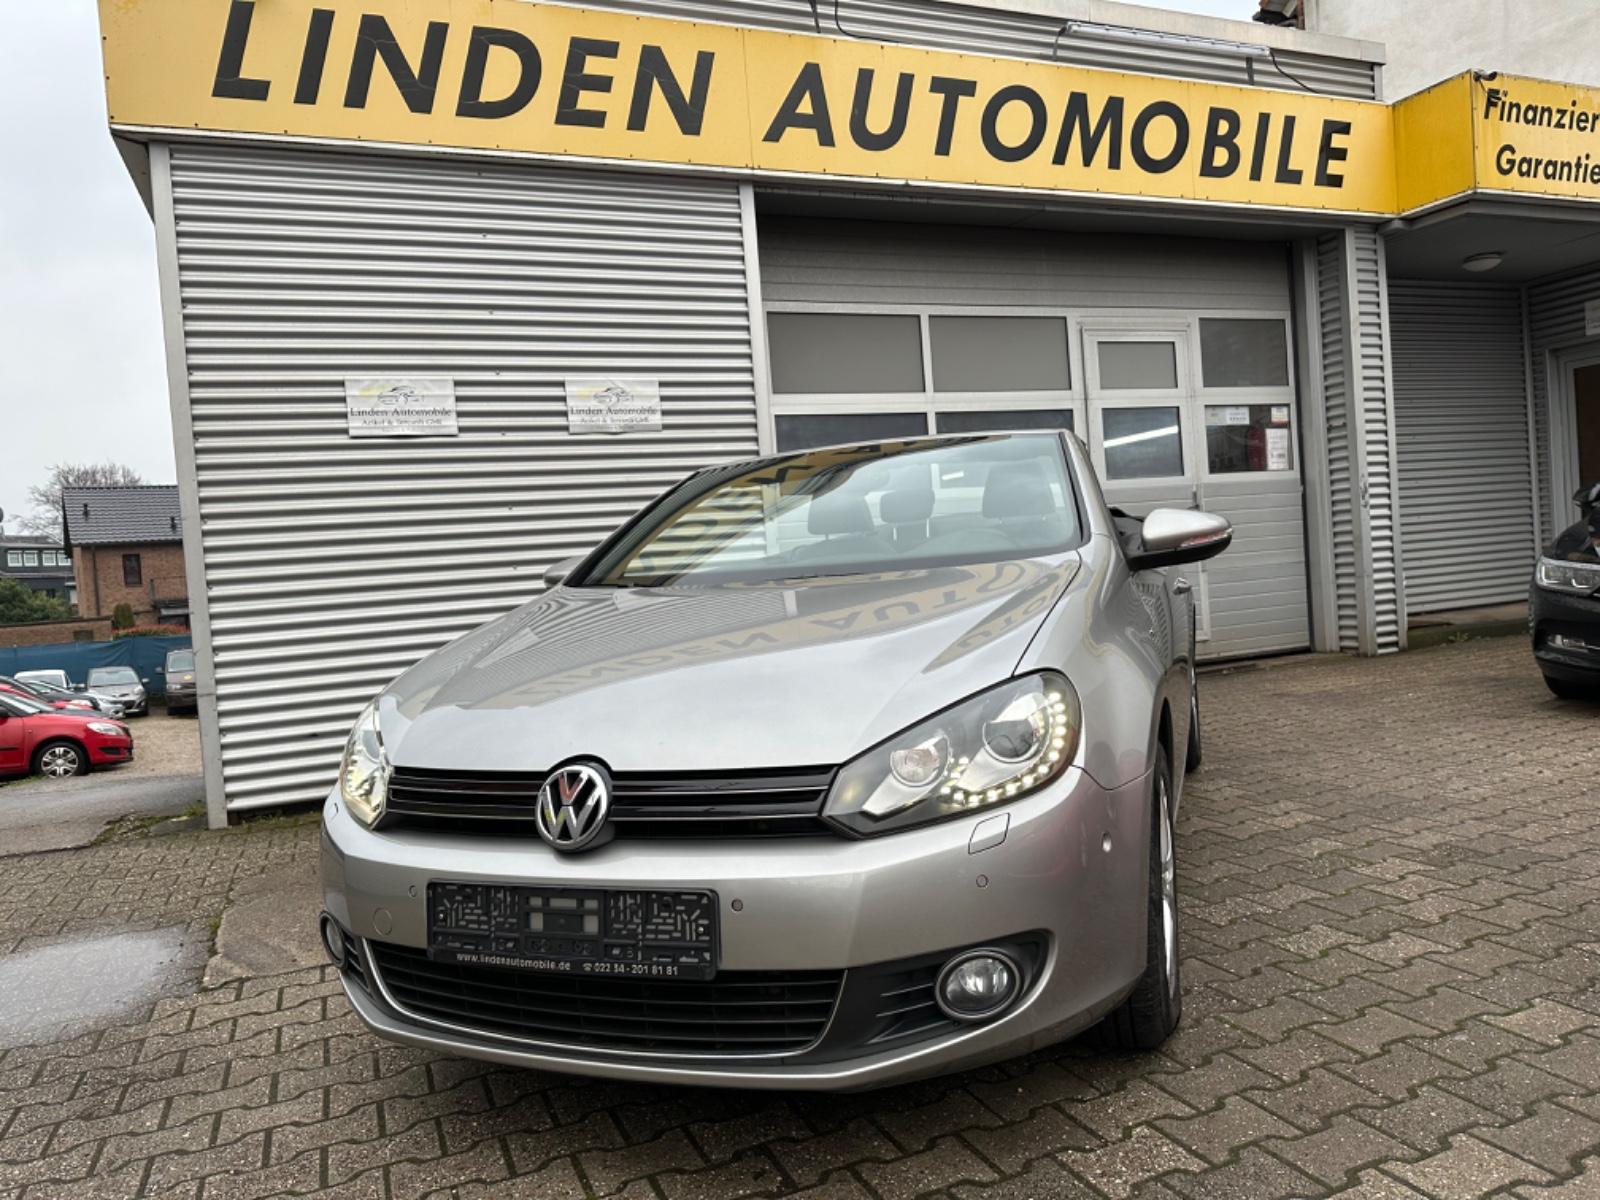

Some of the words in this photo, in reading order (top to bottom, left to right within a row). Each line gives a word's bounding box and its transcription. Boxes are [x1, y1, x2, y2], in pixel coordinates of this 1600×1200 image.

[211, 0, 715, 136] LINDEN
[762, 62, 1352, 188] AUTOMOBILE
[1496, 144, 1600, 184] Garantie
[350, 407, 388, 417] Linden
[392, 407, 453, 417] Automobile
[570, 406, 603, 416] Linden
[606, 406, 658, 416] Automobile
[456, 953, 571, 971] www.lindenautomobile.de
[666, 966, 679, 976] 81
